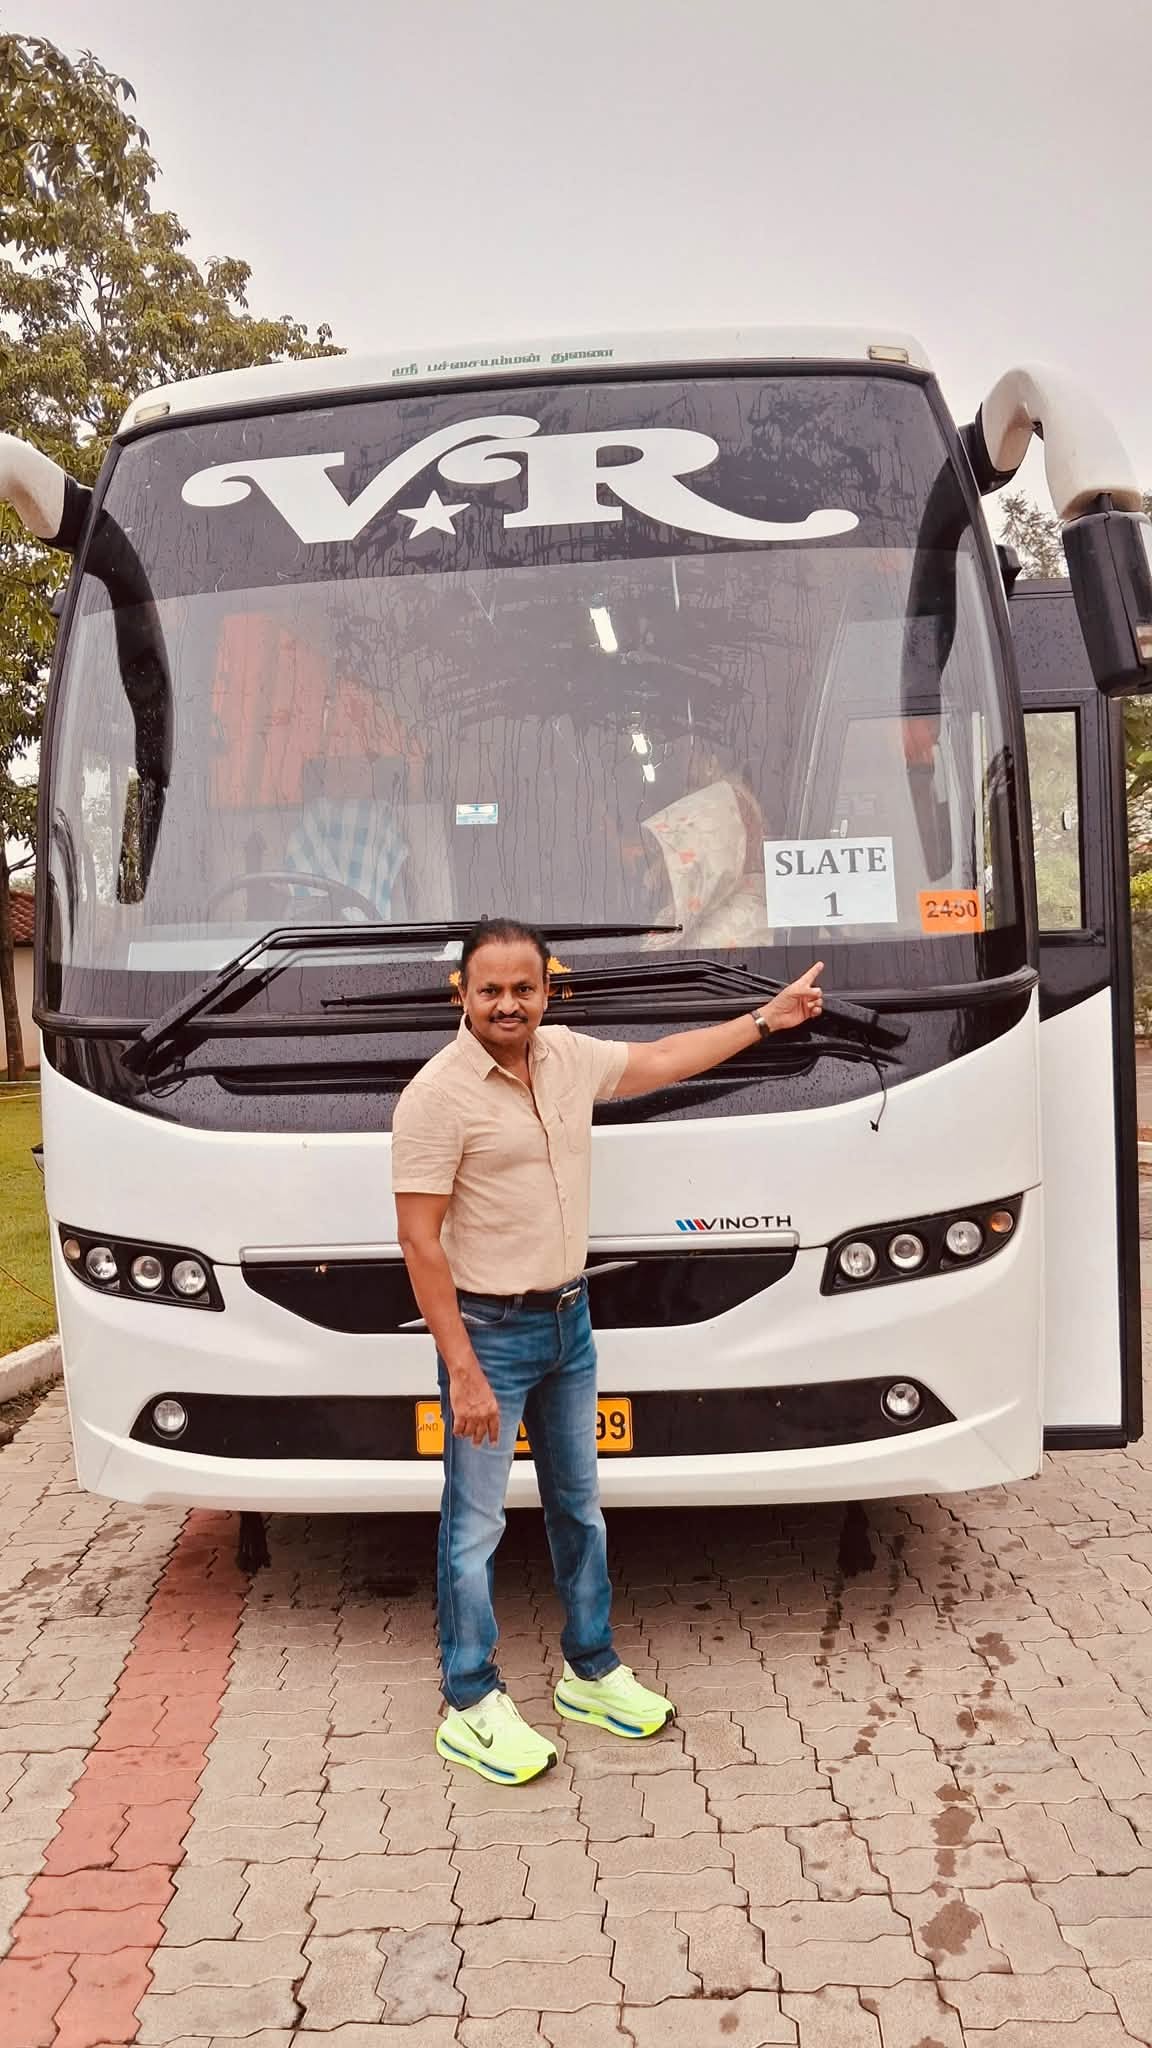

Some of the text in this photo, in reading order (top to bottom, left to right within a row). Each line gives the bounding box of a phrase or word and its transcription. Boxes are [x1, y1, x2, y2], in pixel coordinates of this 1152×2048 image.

[551, 349, 613, 363] துணை
[776, 847, 887, 876] SLATE
[823, 892, 843, 917] 1
[700, 1215, 791, 1230] VINOTH
